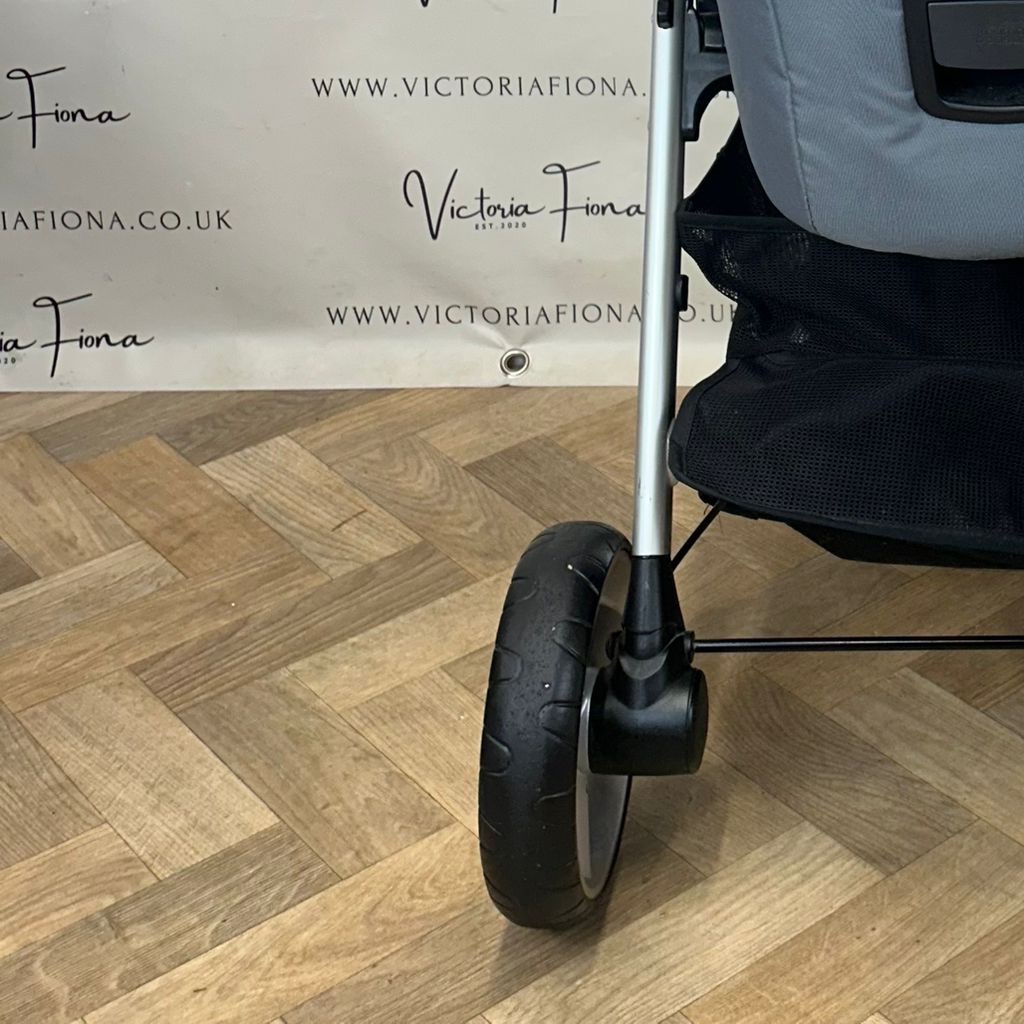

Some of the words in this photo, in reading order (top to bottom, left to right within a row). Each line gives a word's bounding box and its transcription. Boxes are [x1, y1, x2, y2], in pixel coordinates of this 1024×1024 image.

[7, 67, 131, 150] Fiona
[311, 76, 646, 98] WWW.VICTORIAFIONA.
[403, 168, 546, 241] Victoria
[542, 161, 646, 243] Fiona
[32, 293, 155, 378] Fiona
